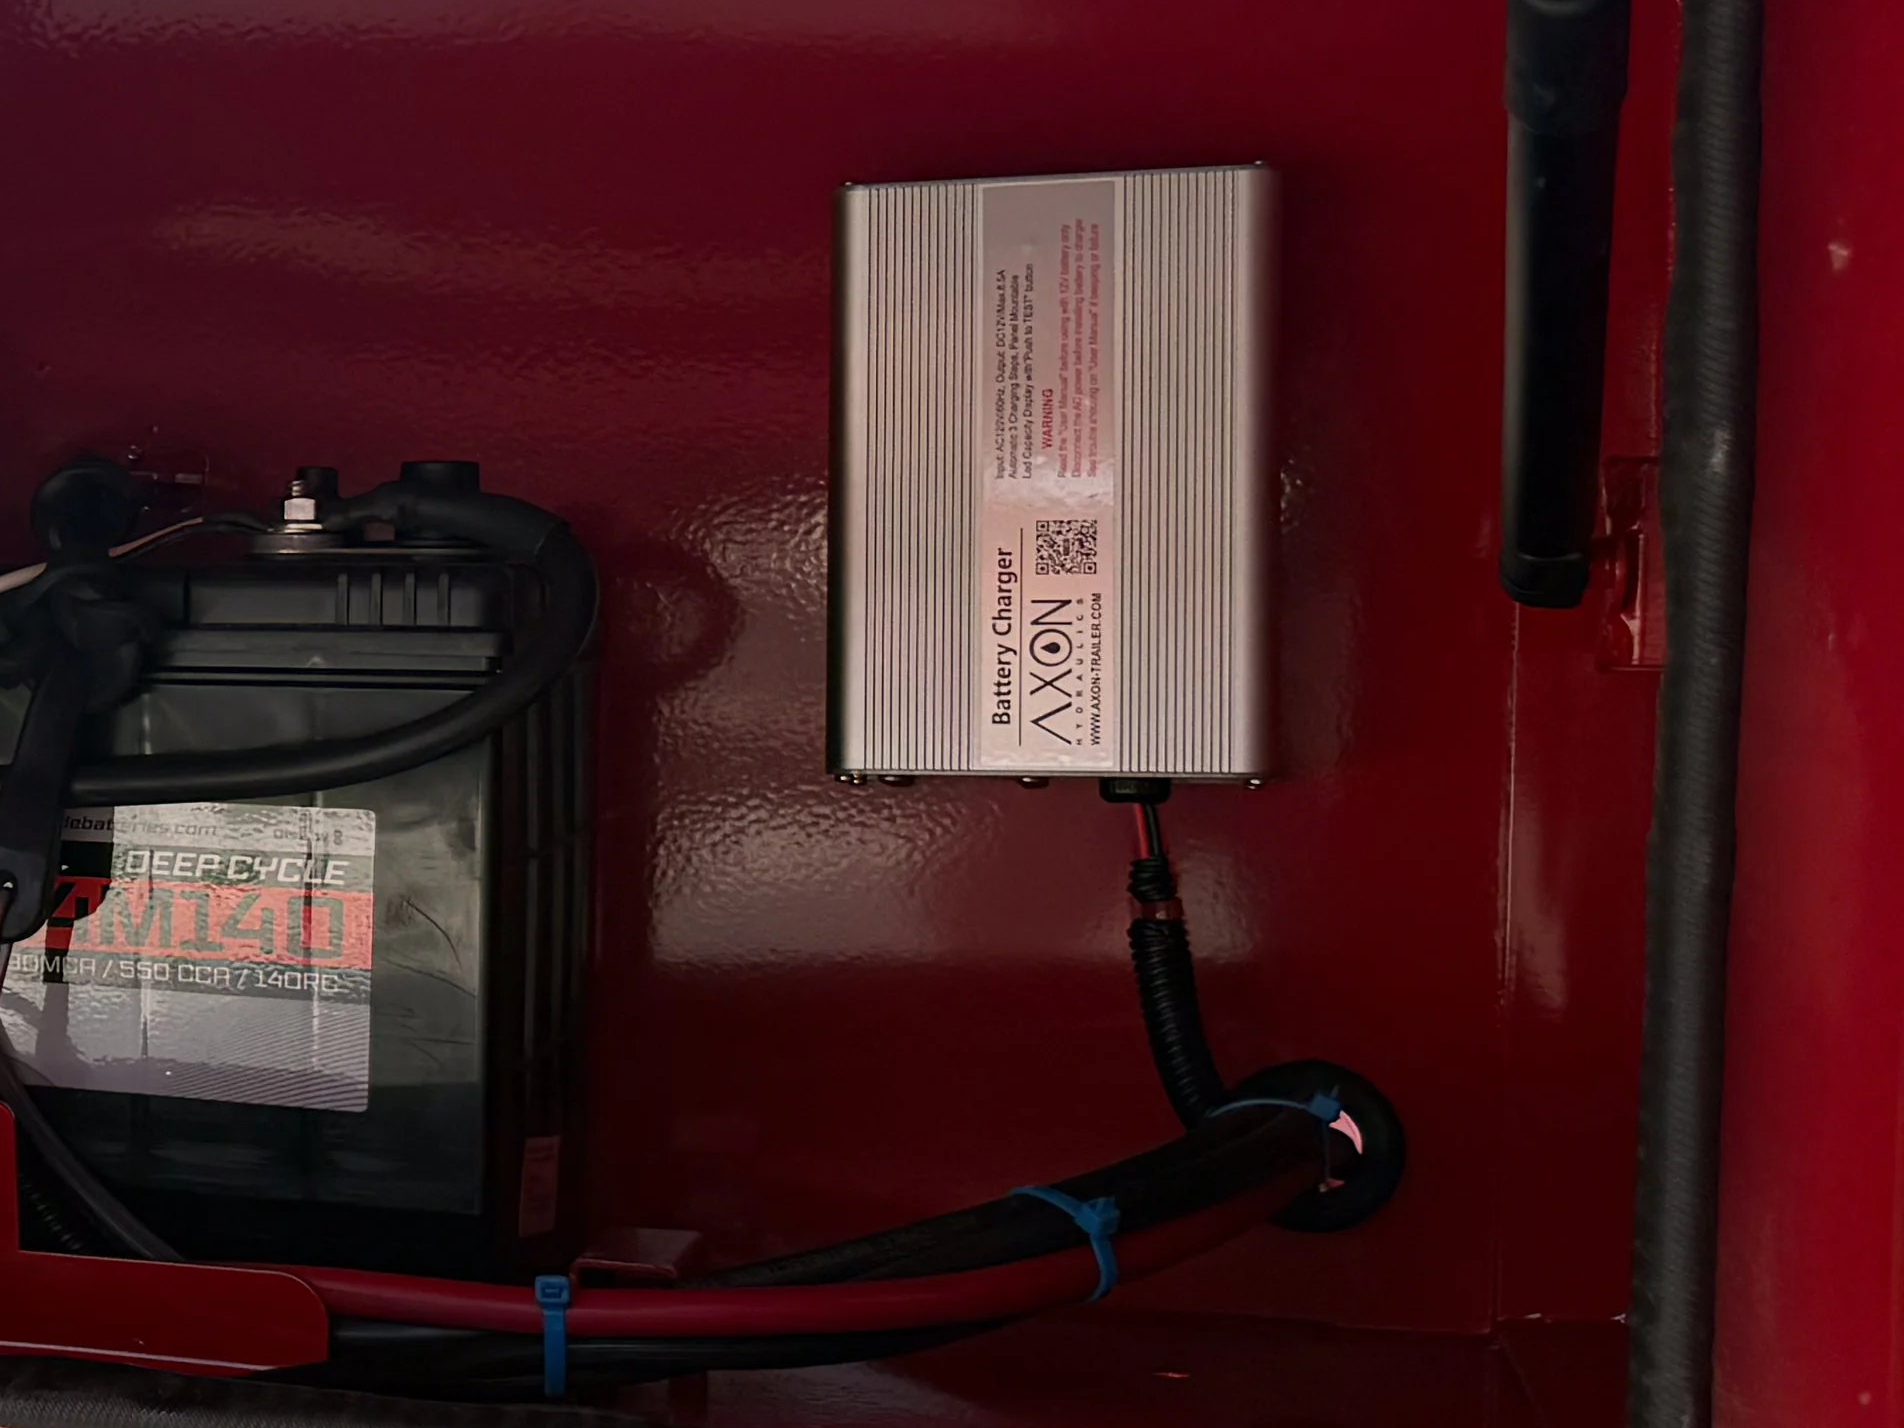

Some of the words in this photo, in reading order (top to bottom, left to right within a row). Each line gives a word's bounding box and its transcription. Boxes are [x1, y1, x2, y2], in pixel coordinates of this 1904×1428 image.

[1042, 389, 1053, 449] WARNING
[992, 548, 1017, 636] Charger
[992, 644, 1016, 724] Battery
[1029, 599, 1072, 745] AXON
[1090, 593, 1101, 745] WWW.AXON-TRAILER.COM
[124, 850, 222, 878] DEEP
[226, 855, 352, 886] CYCLE
[46, 881, 345, 961] 4M140
[119, 959, 171, 982] 550
[177, 963, 232, 986] CCA
[255, 968, 340, 993] 140RC
